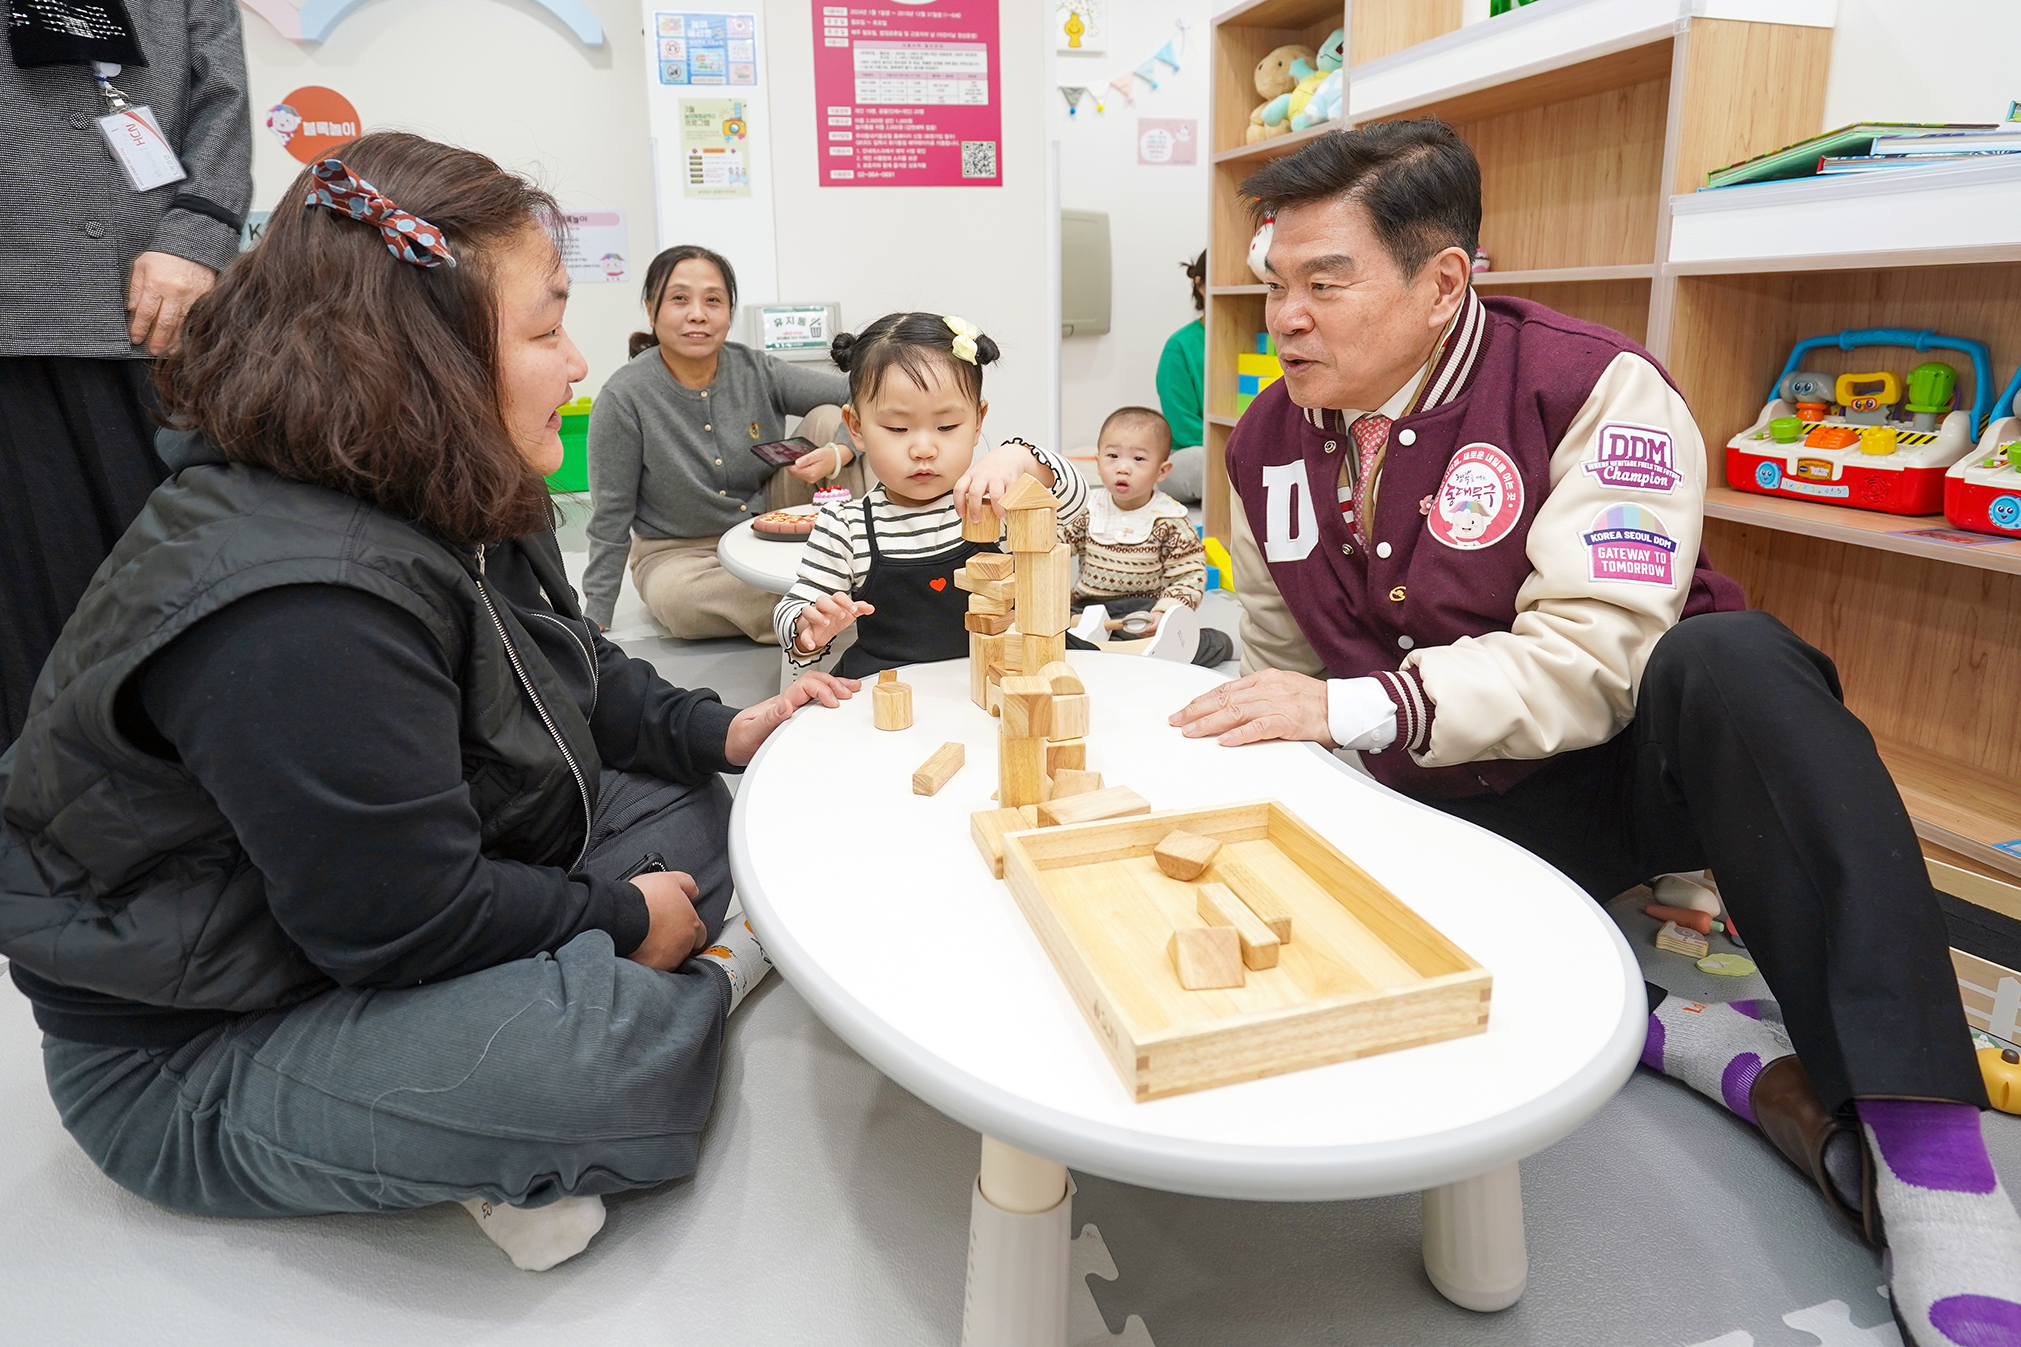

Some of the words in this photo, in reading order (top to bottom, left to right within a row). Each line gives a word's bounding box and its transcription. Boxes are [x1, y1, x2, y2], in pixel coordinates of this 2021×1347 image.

[303, 121, 356, 136] 블록놀이
[1608, 433, 1667, 467] DDM
[1463, 450, 1485, 460] 새로운
[1485, 453, 1507, 473] 내일을
[1603, 466, 1668, 487] Champion
[1262, 459, 1319, 563] D
[1590, 531, 1622, 542] KOREA
[1624, 531, 1652, 543] SEOUL
[1653, 536, 1672, 549] DDM
[1598, 547, 1650, 562] GATEWAY
[1654, 551, 1667, 564] TO
[1601, 560, 1665, 577] TOMORROW
